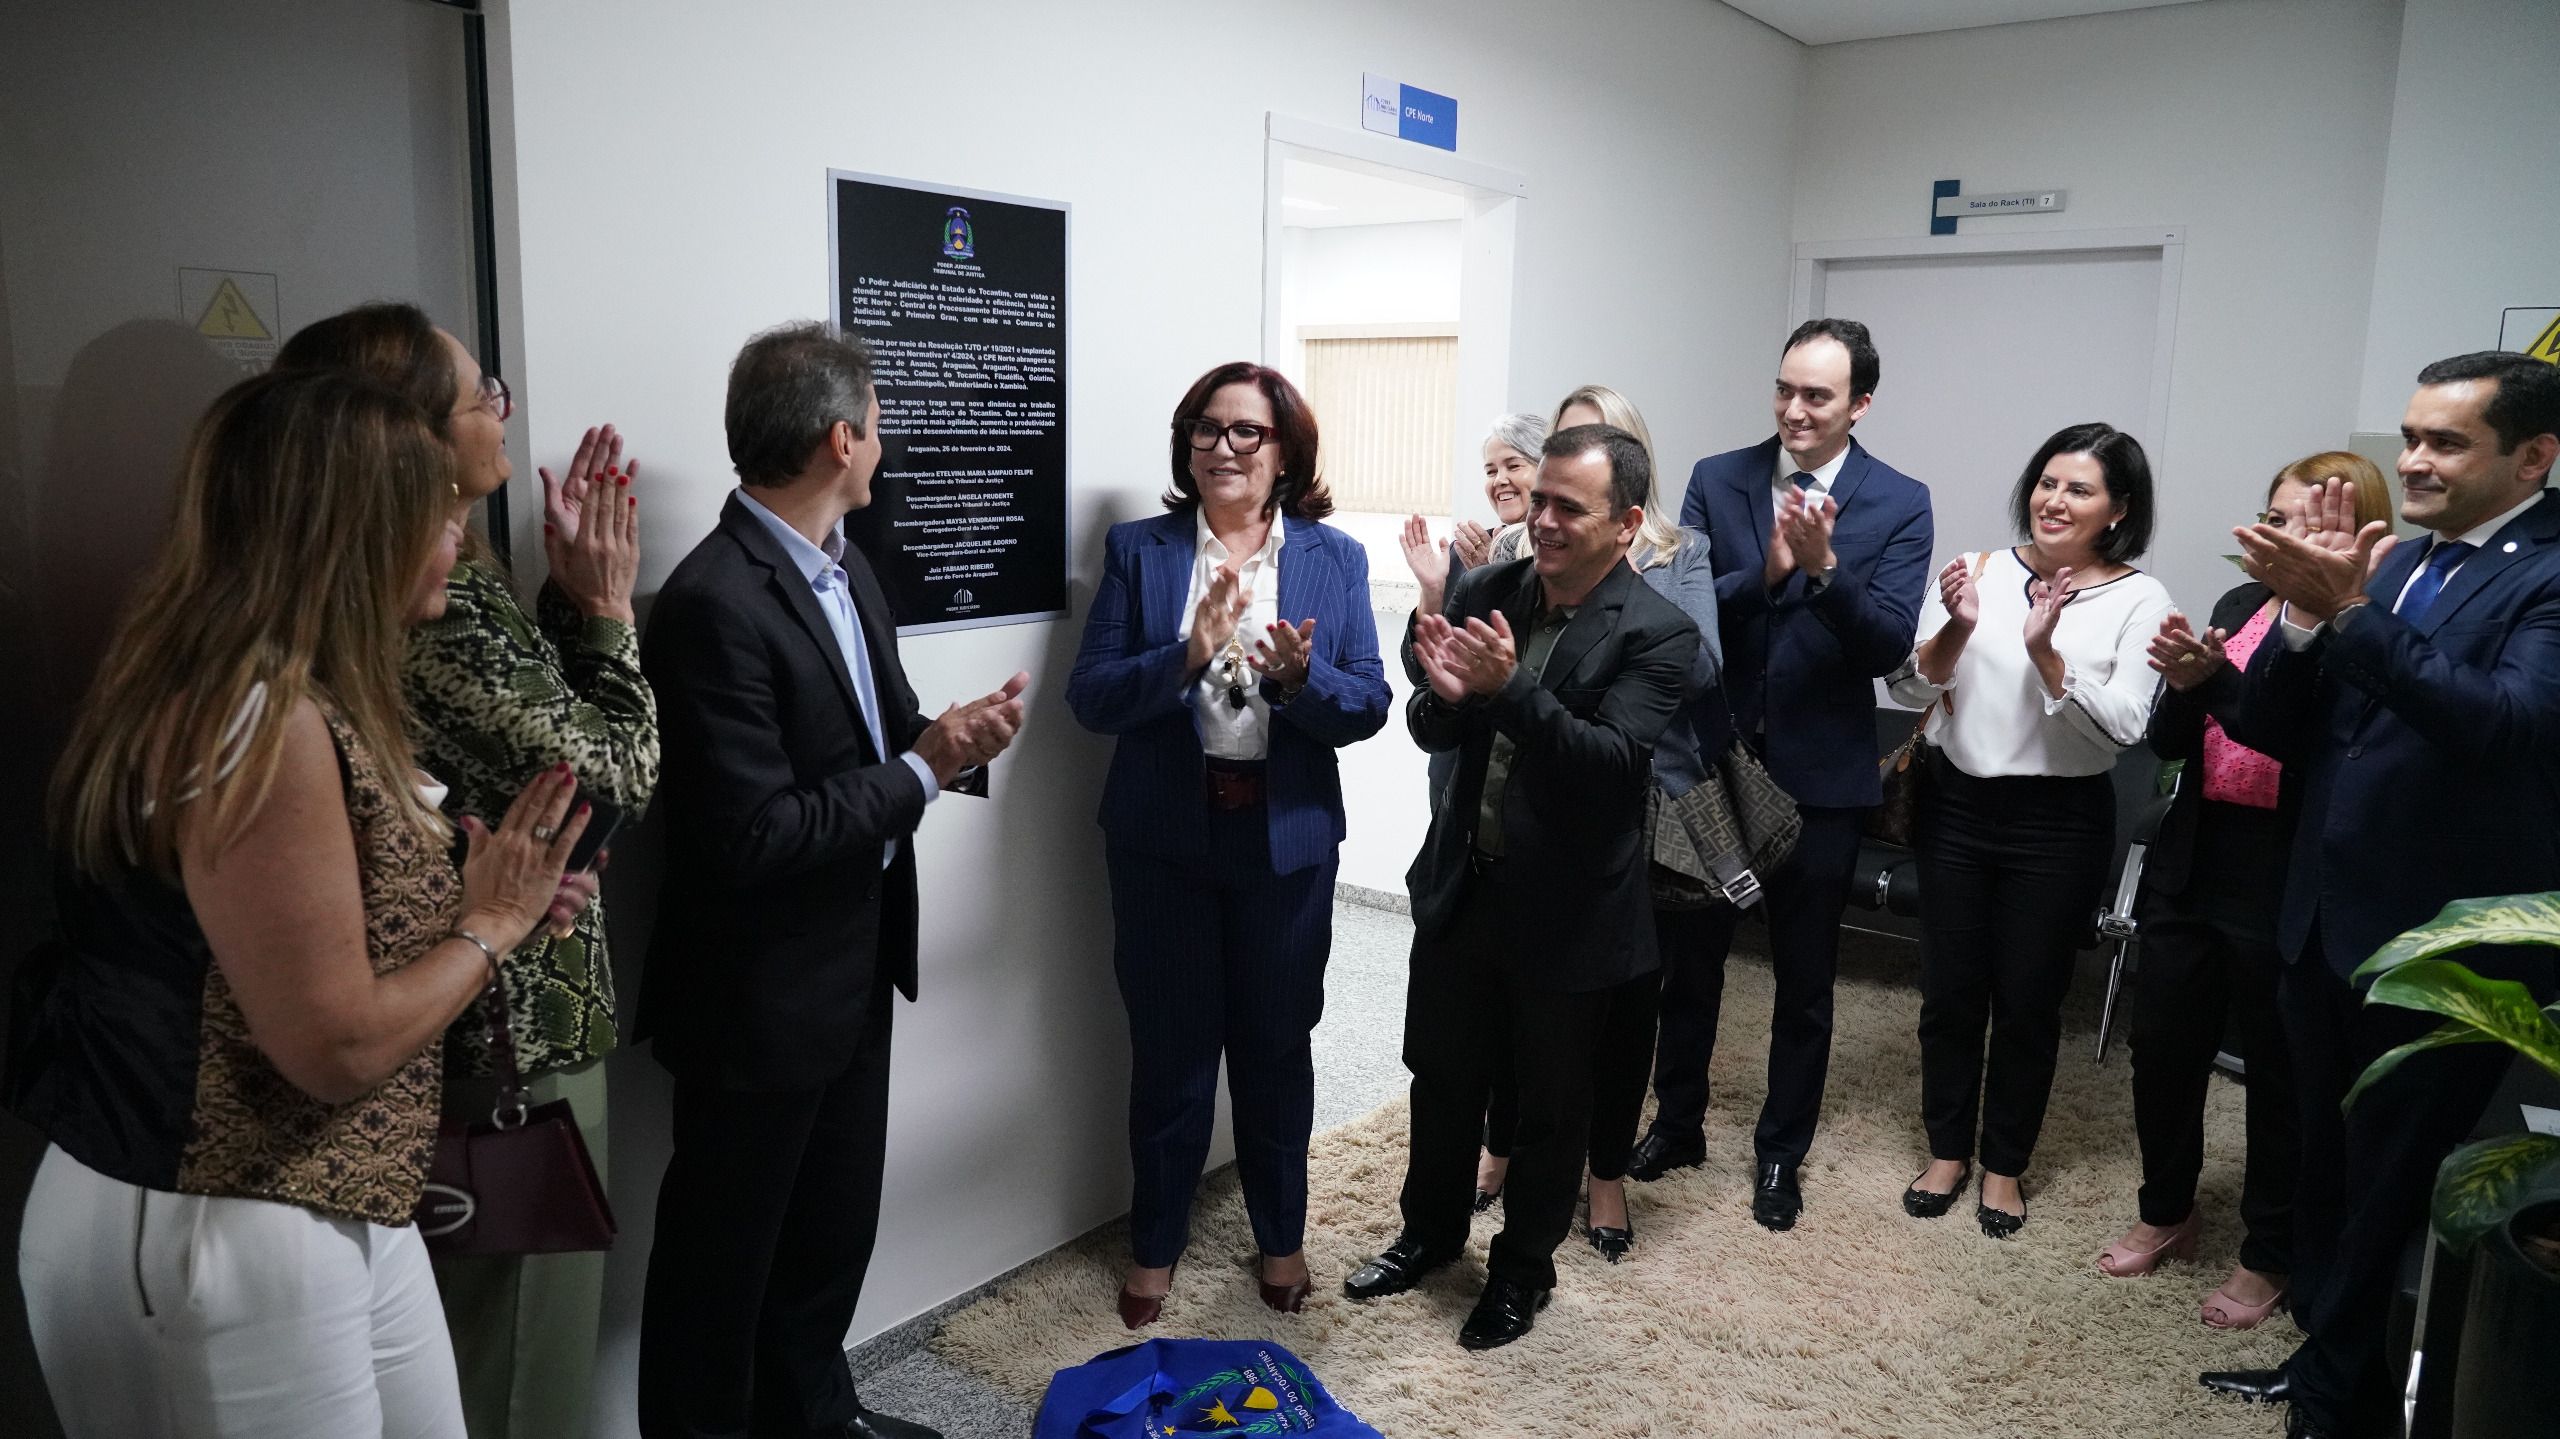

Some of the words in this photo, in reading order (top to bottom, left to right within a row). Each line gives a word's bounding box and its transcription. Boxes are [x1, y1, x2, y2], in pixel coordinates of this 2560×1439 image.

[1406, 106, 1416, 118] CPE
[1418, 110, 1433, 124] Norte
[853, 287, 881, 296] atender
[949, 296, 983, 304] celeridade
[869, 278, 889, 286] Poder
[893, 280, 927, 290] Judiciário
[942, 285, 964, 293] Estado
[979, 288, 1011, 298] Tocantins,
[853, 307, 886, 316] Judiciais
[906, 311, 935, 319] Primeiro
[940, 314, 958, 322] Grau,
[900, 301, 925, 309] Central
[940, 304, 990, 314] Processamento
[928, 342, 963, 351] Resolução
[1022, 347, 1055, 355] implantada
[907, 350, 942, 358] Normativa
[952, 352, 975, 361] 4/2024,
[1017, 356, 1047, 364] abrangerá
[910, 360, 937, 368] Ananás,
[983, 364, 1018, 372] Araguatins,
[903, 543, 953, 551] Desembargadora
[1244, 1369, 1259, 1384] 1989
[1259, 1351, 1290, 1391] TOCANTINS
[1288, 1391, 1298, 1402] DO
[1295, 1405, 1315, 1429] ESTADO
